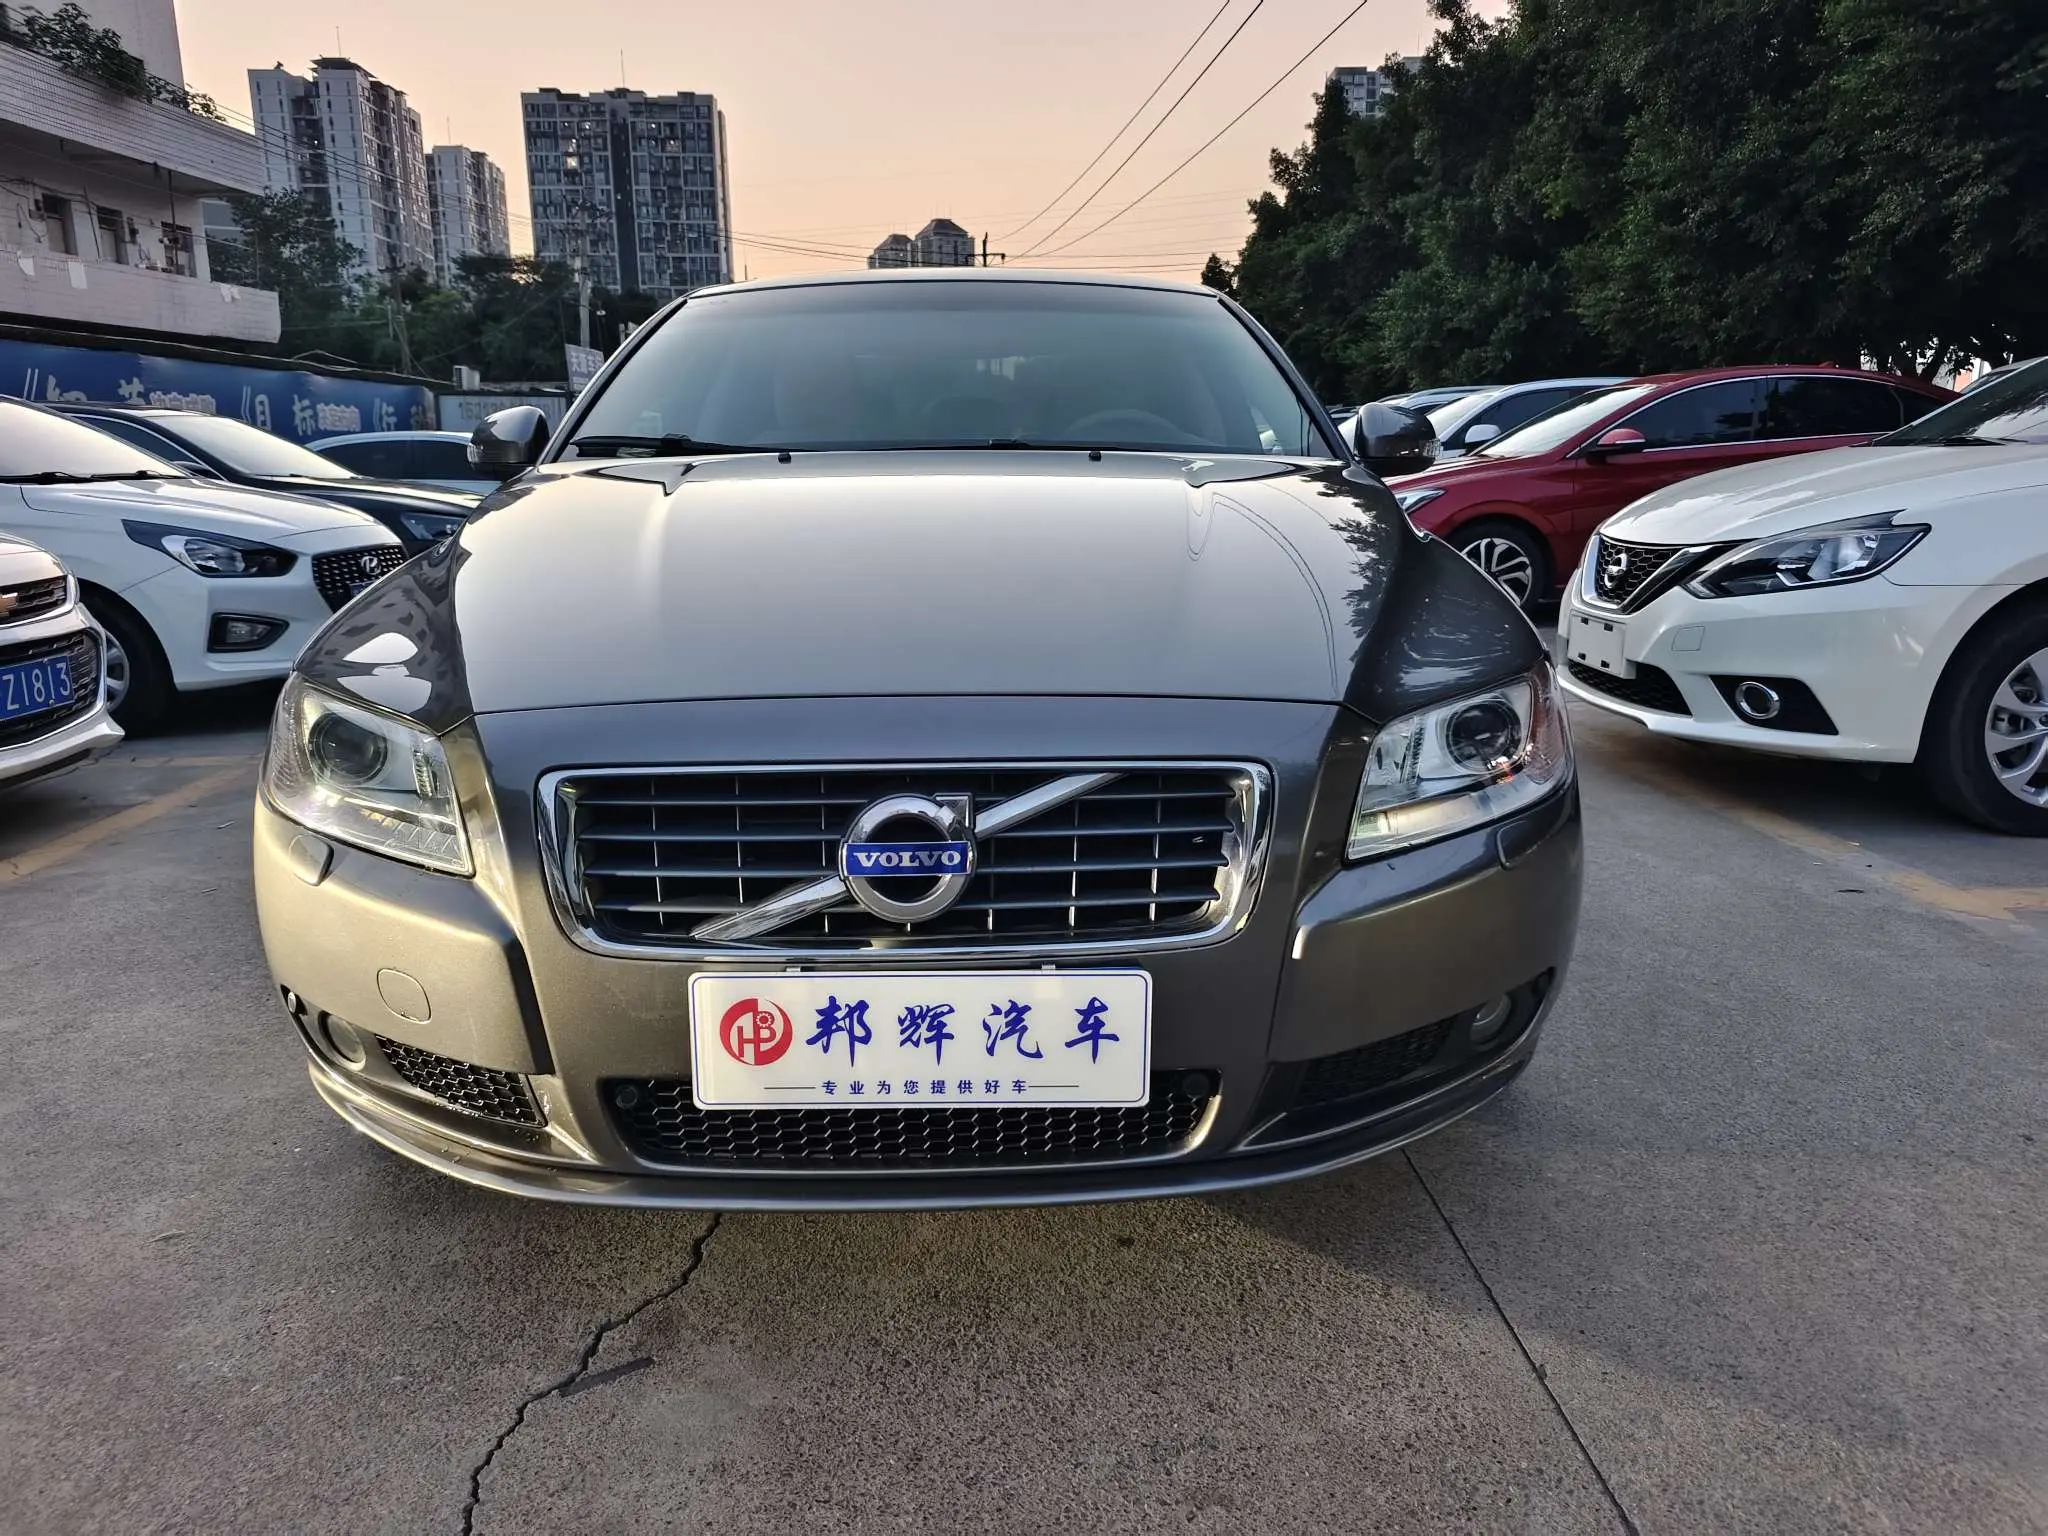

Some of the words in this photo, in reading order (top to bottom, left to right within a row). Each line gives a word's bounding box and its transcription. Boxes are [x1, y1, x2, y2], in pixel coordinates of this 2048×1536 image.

[2, 662, 70, 710] Z1813
[853, 850, 961, 868] VOLVO
[806, 996, 1120, 1067] 邦辉汽车
[821, 1080, 1027, 1095] 专业为您提供好车
